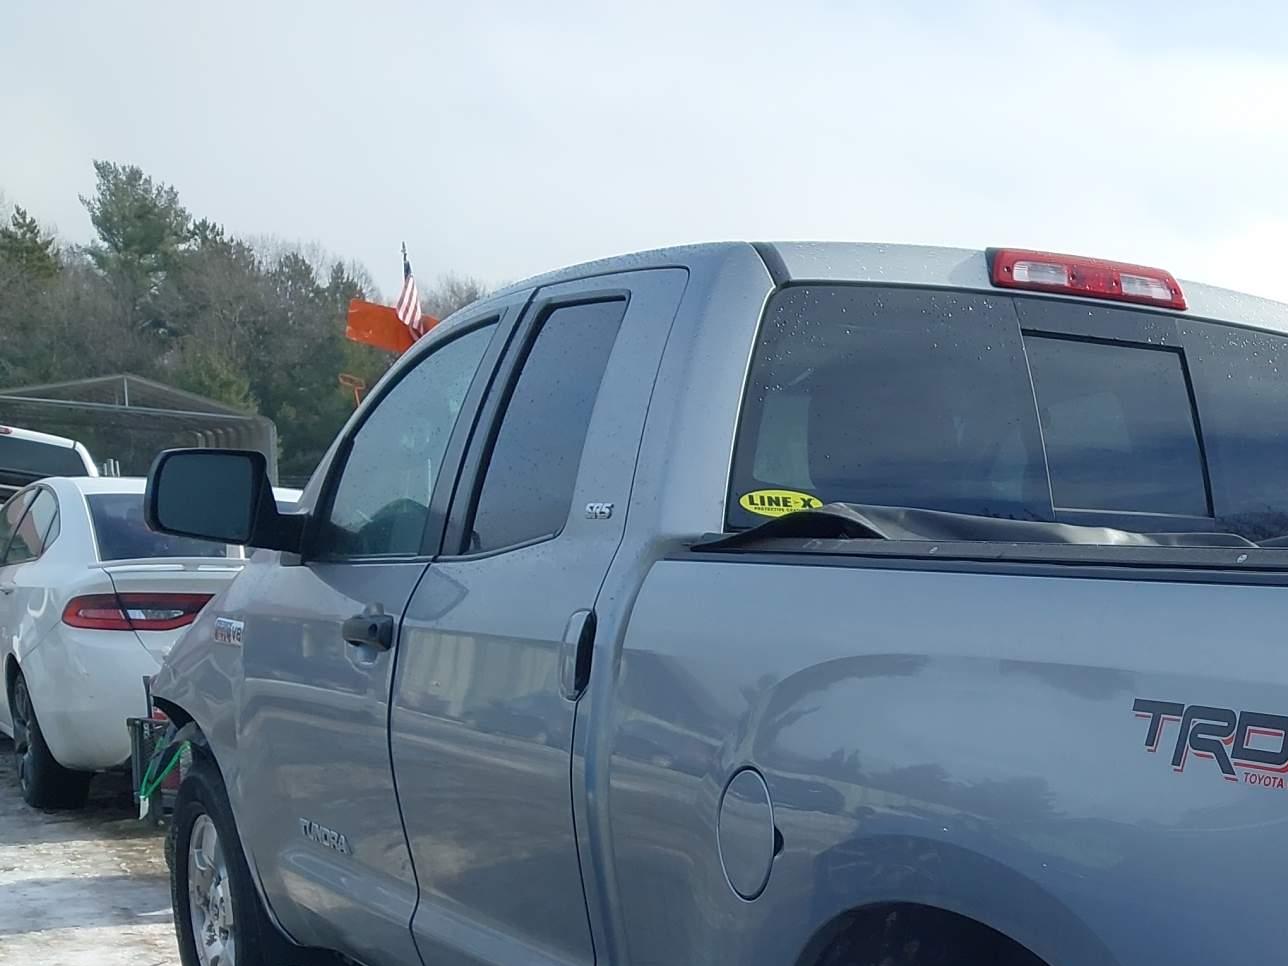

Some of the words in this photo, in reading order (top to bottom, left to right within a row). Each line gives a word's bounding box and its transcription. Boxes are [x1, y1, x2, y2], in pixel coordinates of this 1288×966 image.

[748, 494, 814, 508] LINE-X
[1242, 771, 1285, 790] TOYOTA
[299, 817, 353, 855] TUNDRA
